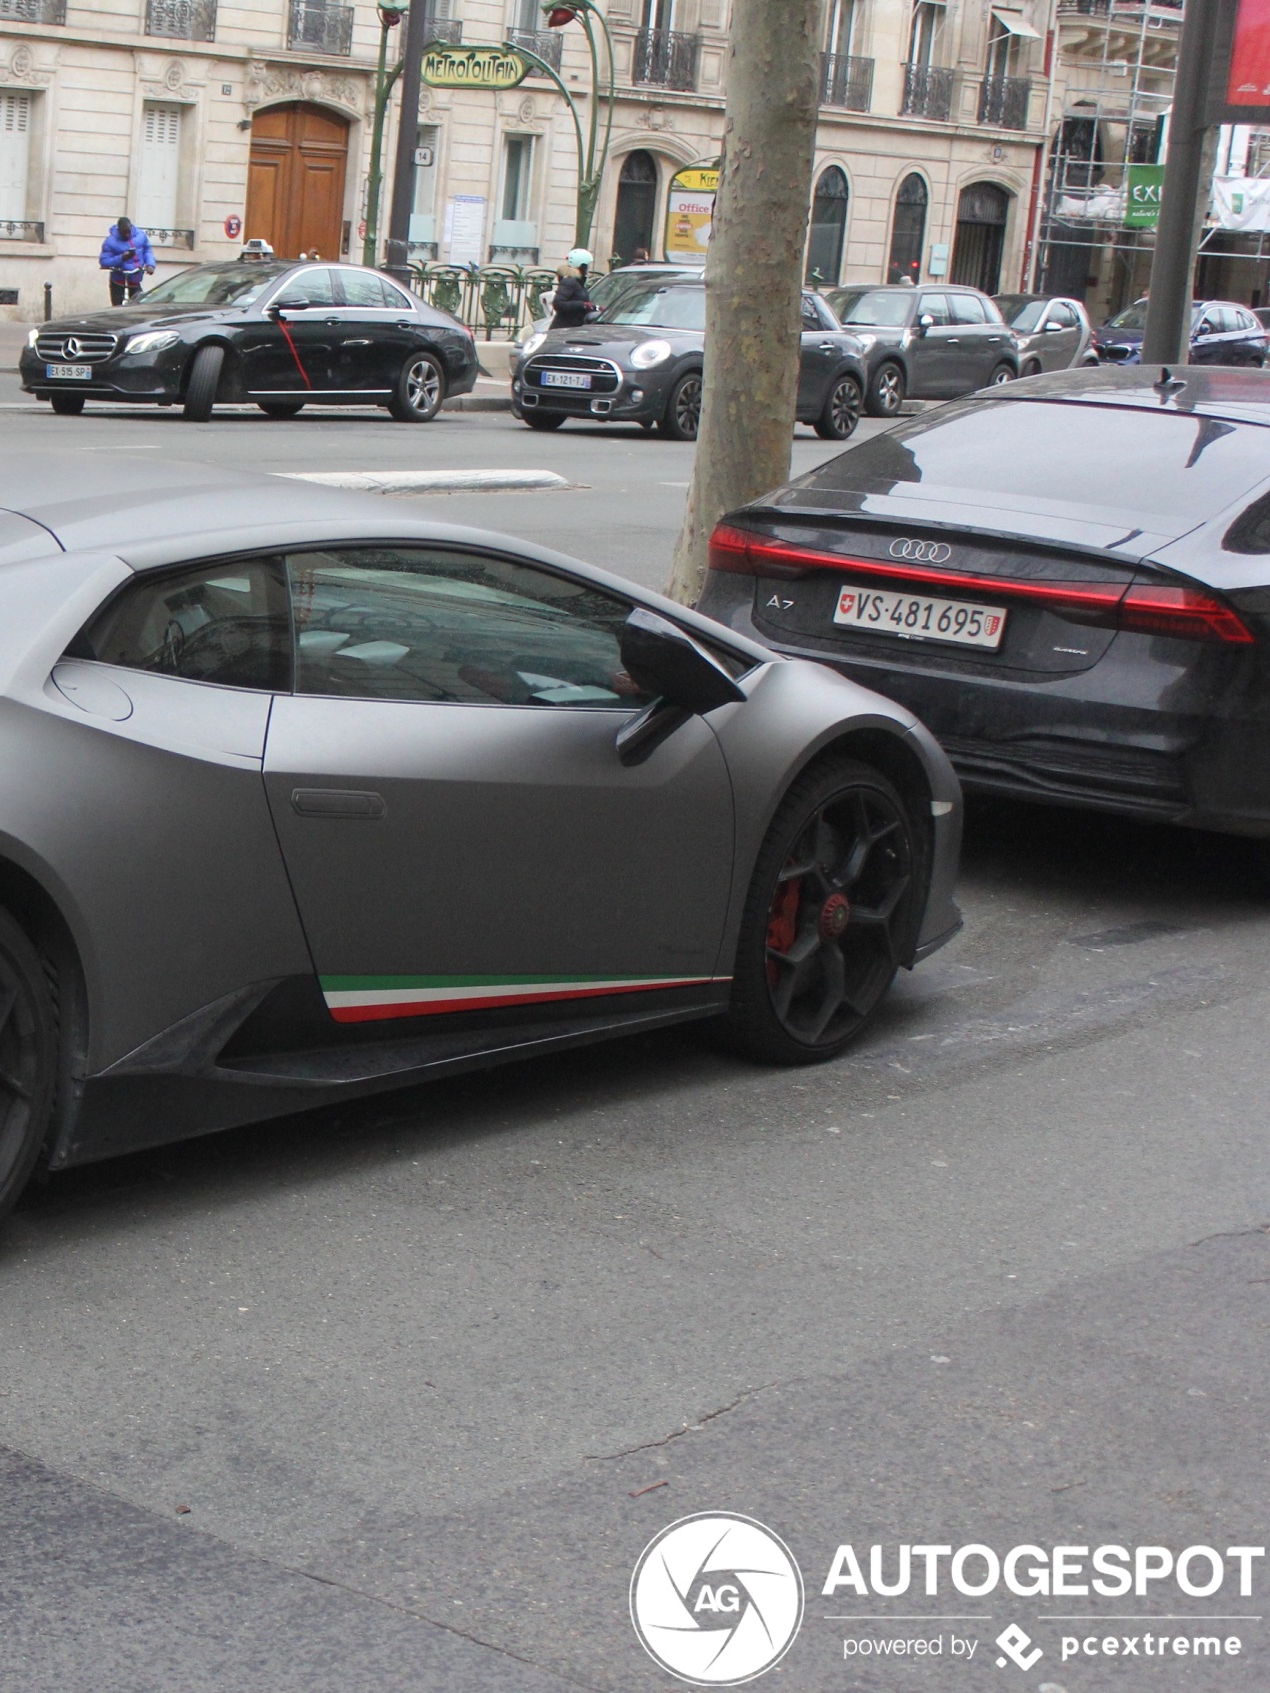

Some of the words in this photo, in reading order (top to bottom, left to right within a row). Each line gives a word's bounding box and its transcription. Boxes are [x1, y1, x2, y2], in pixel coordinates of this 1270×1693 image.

[419, 152, 427, 161] 14
[678, 203, 709, 213] Office
[766, 594, 794, 609] A7
